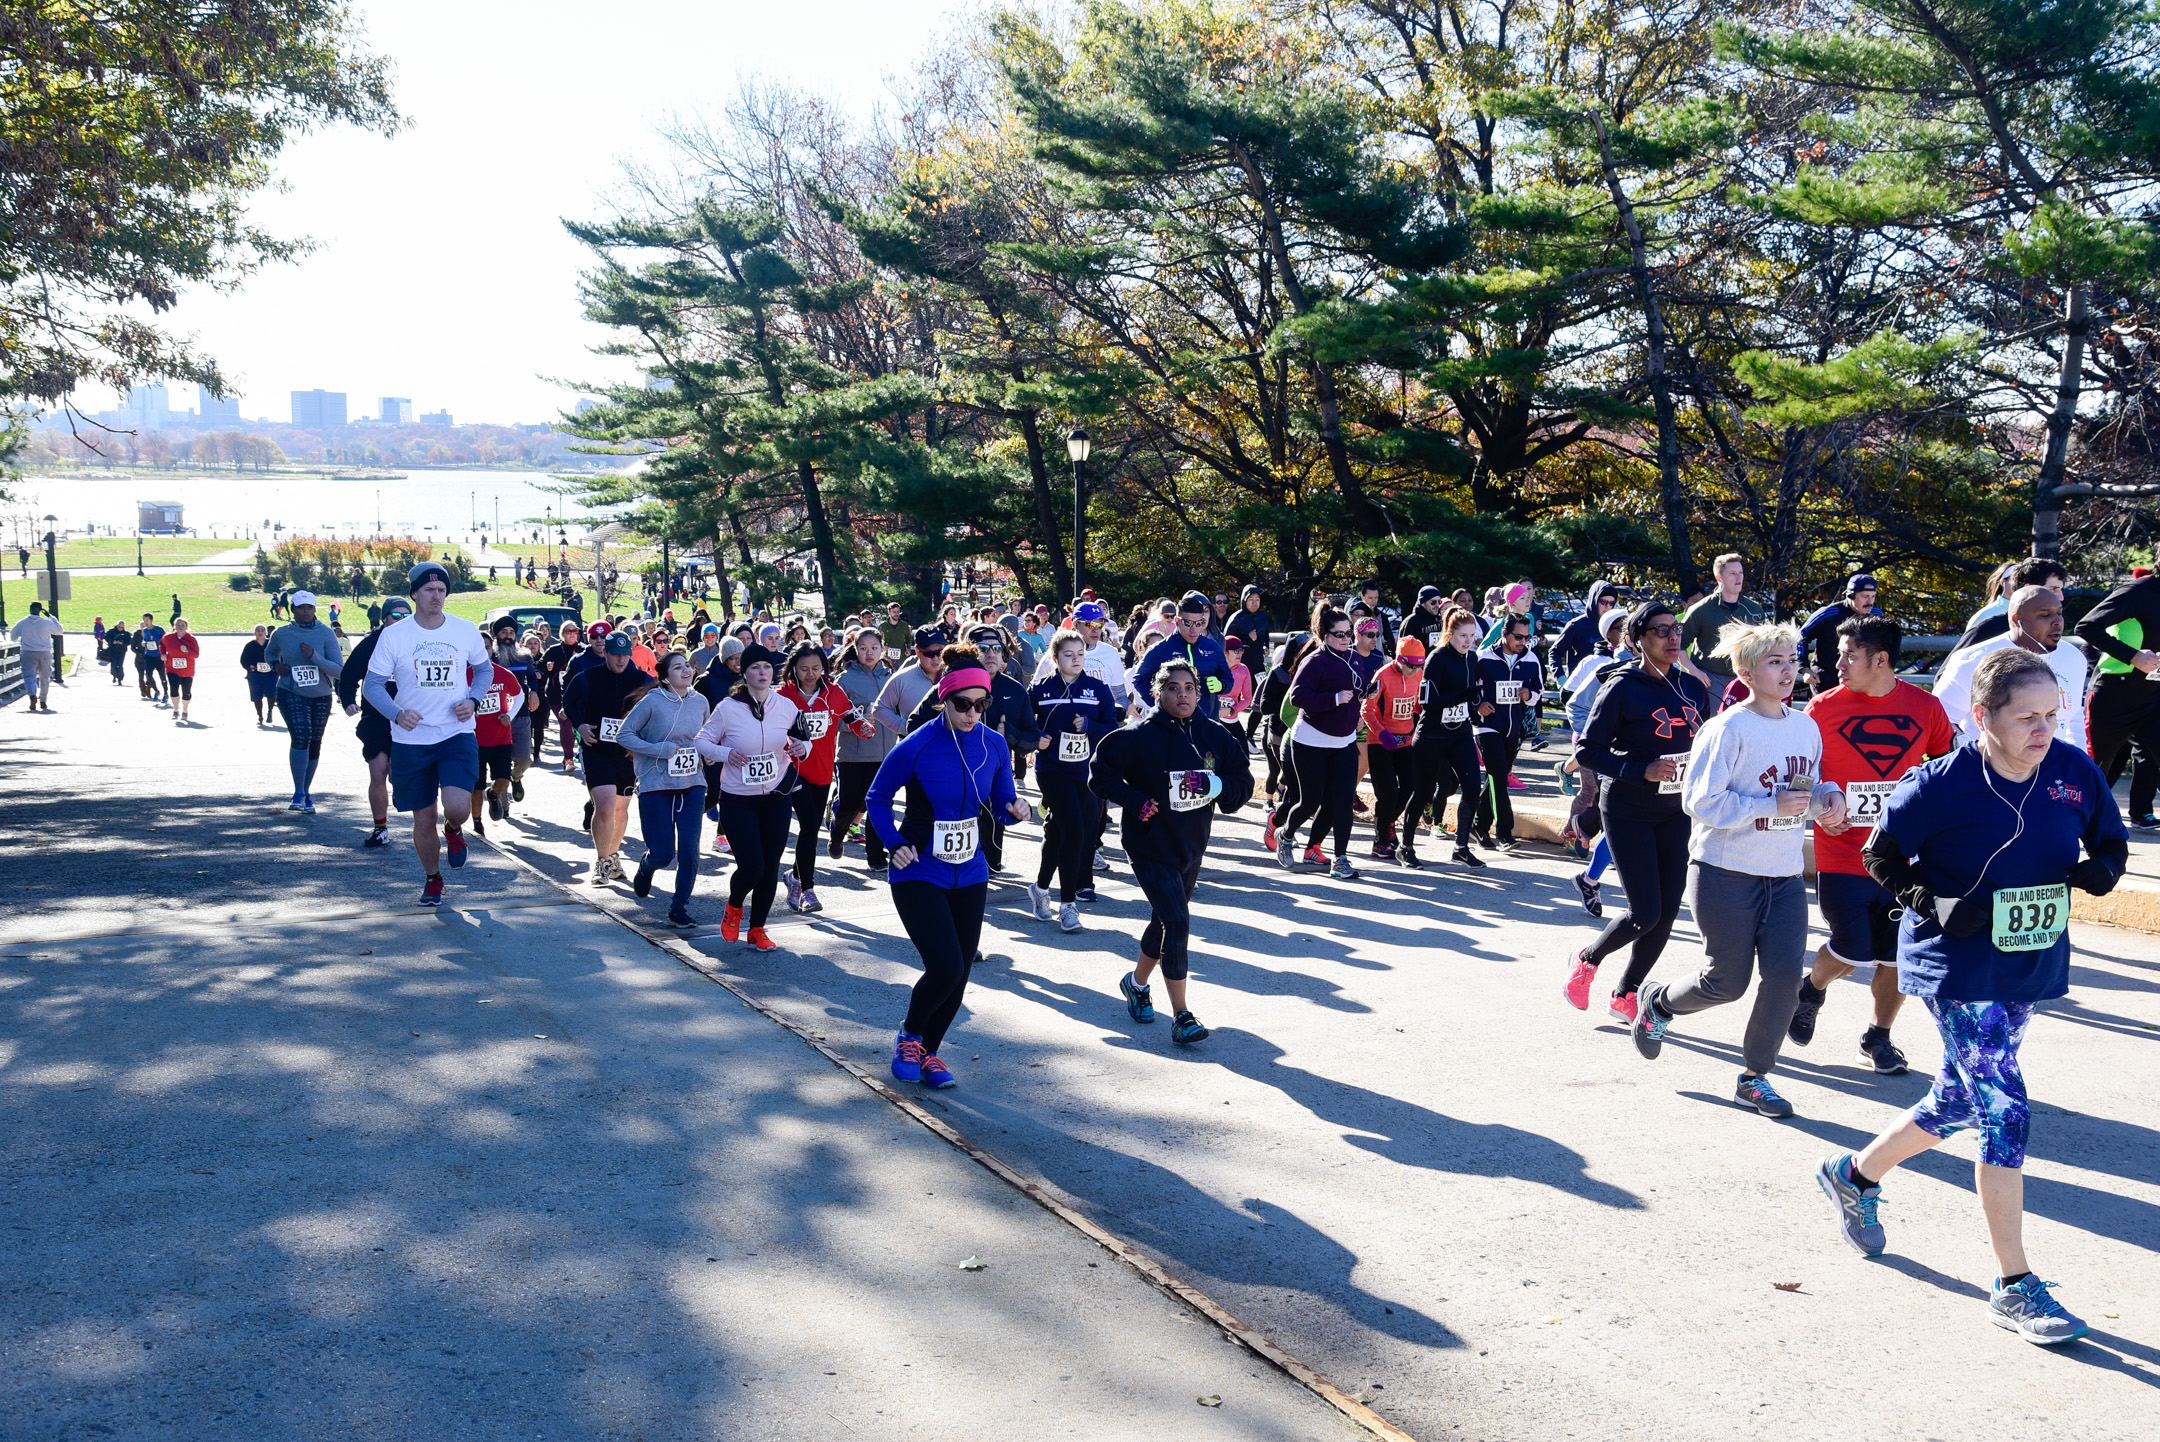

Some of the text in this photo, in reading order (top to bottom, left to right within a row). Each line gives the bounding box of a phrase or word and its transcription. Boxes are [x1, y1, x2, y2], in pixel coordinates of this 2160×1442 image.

[297, 670, 315, 681] 590
[426, 667, 450, 681] 137
[1502, 687, 1518, 698] 181
[481, 699, 497, 709] 212
[606, 725, 619, 736] 23
[1066, 741, 1087, 754] 421
[675, 755, 694, 768] 425
[749, 761, 772, 777] 620
[1663, 783, 1680, 791] BECOME
[1759, 765, 1778, 797] ST
[1851, 783, 1896, 792] RUN AND BECOM
[938, 823, 948, 831] RUN
[951, 823, 961, 831] AND
[1773, 818, 1792, 826] BECOME
[944, 831, 971, 852] 631
[2000, 886, 2064, 903] RUN AND BECOME
[2008, 903, 2057, 933] 838
[1998, 934, 2031, 947] BECOME
[2033, 933, 2047, 945] AND
